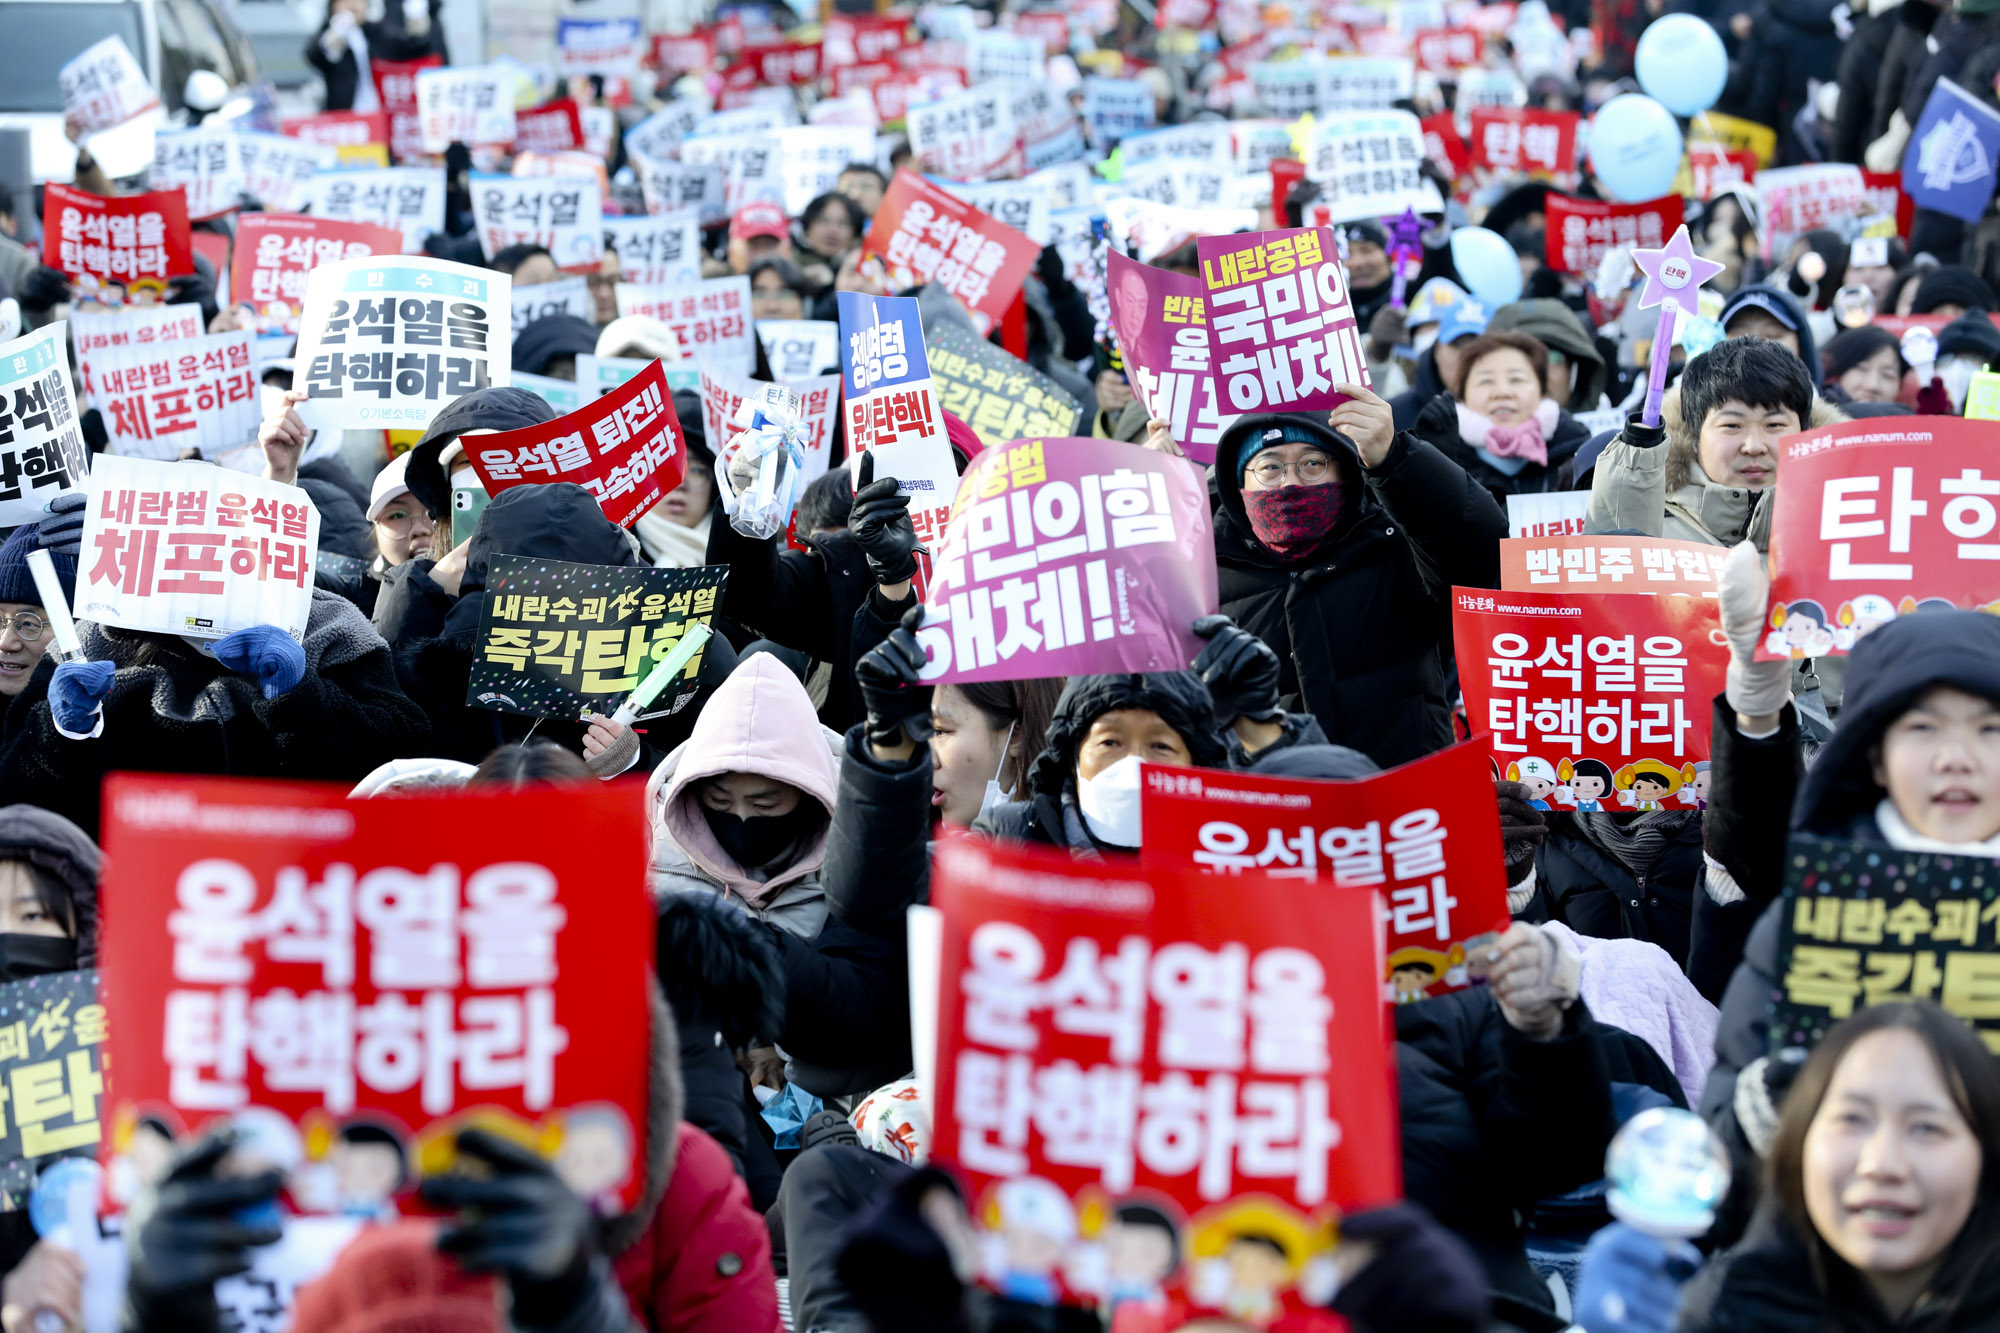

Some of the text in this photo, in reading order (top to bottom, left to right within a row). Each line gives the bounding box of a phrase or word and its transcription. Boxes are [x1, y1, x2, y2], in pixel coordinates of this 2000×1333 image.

[1483, 122, 1561, 172] 탄핵
[326, 180, 428, 217] 윤석열
[483, 188, 581, 228] 윤석열
[60, 207, 166, 247] 윤석열을
[901, 200, 1007, 279] 윤석열을
[61, 242, 169, 280] 탄핵하라
[887, 229, 991, 309] 탄핵하라
[1204, 230, 1323, 290] 내란공범
[1664, 265, 1687, 280] 탄핵
[320, 297, 489, 352] 윤석열을
[102, 341, 249, 395] 내란범 윤석열
[304, 351, 493, 401] 탄핵하라
[927, 346, 1006, 393] 내란수괴
[1220, 326, 1372, 410] 해체!
[109, 371, 257, 441] 체포하라
[369, 408, 426, 420] 기본소득당
[479, 430, 592, 481] 윤석열
[591, 381, 665, 456] 퇴진!!
[1788, 431, 1933, 458] 나눔문화 www.nanum.com
[100, 490, 309, 540] 내란범 윤석열
[88, 527, 310, 598] 체포하라
[1525, 547, 1634, 584] 반민주
[491, 585, 718, 623] 내란수괴 윤석열
[916, 559, 1115, 681] 해체!
[1458, 595, 1582, 616] 나눔문화 www.nanum.com
[1488, 633, 1688, 692] 윤석열을
[1489, 696, 1692, 757] 탄핵하라
[1205, 786, 1311, 809] www.nanum.com
[168, 858, 566, 988] 윤석열을
[1792, 895, 1981, 948] 내란수괴
[962, 920, 1333, 1074] 윤석열을
[163, 986, 570, 1115] 탄핵하라
[955, 1048, 1342, 1199] 탄핵하라
